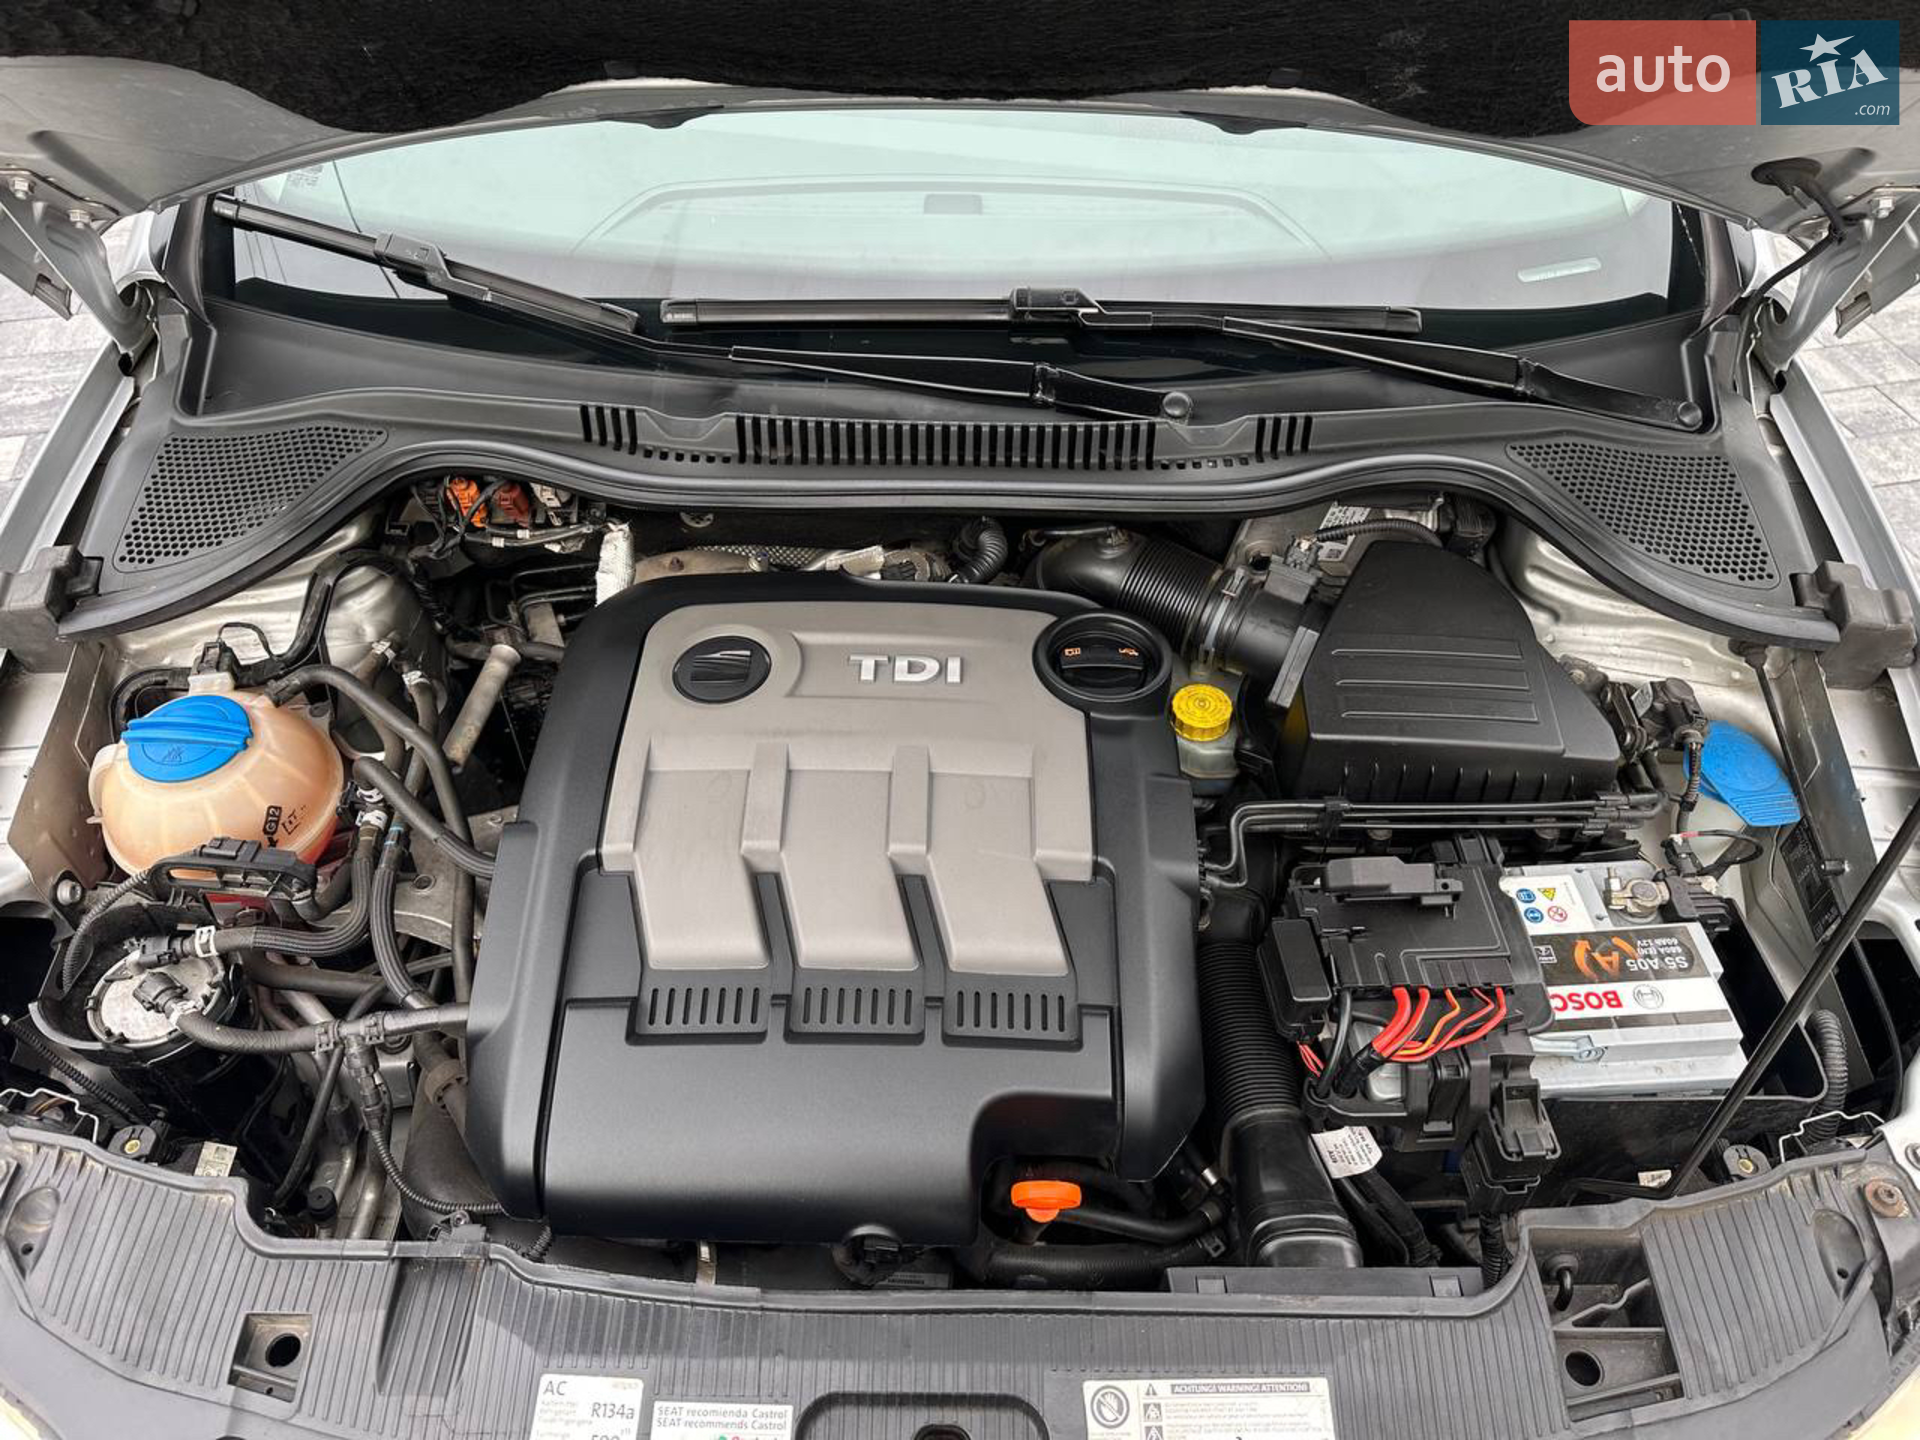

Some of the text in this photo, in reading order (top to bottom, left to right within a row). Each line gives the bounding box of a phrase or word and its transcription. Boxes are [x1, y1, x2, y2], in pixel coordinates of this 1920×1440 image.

[849, 655, 963, 683] TDI
[266, 808, 280, 832] G12
[1625, 956, 1689, 972] S5 A05
[1549, 990, 1624, 1012] BOSC
[542, 1380, 568, 1396] AC
[590, 1402, 636, 1420] R134a
[657, 1406, 788, 1419] SEAT recomienda Castrol
[656, 1417, 787, 1431] SEAT recommends Castrol
